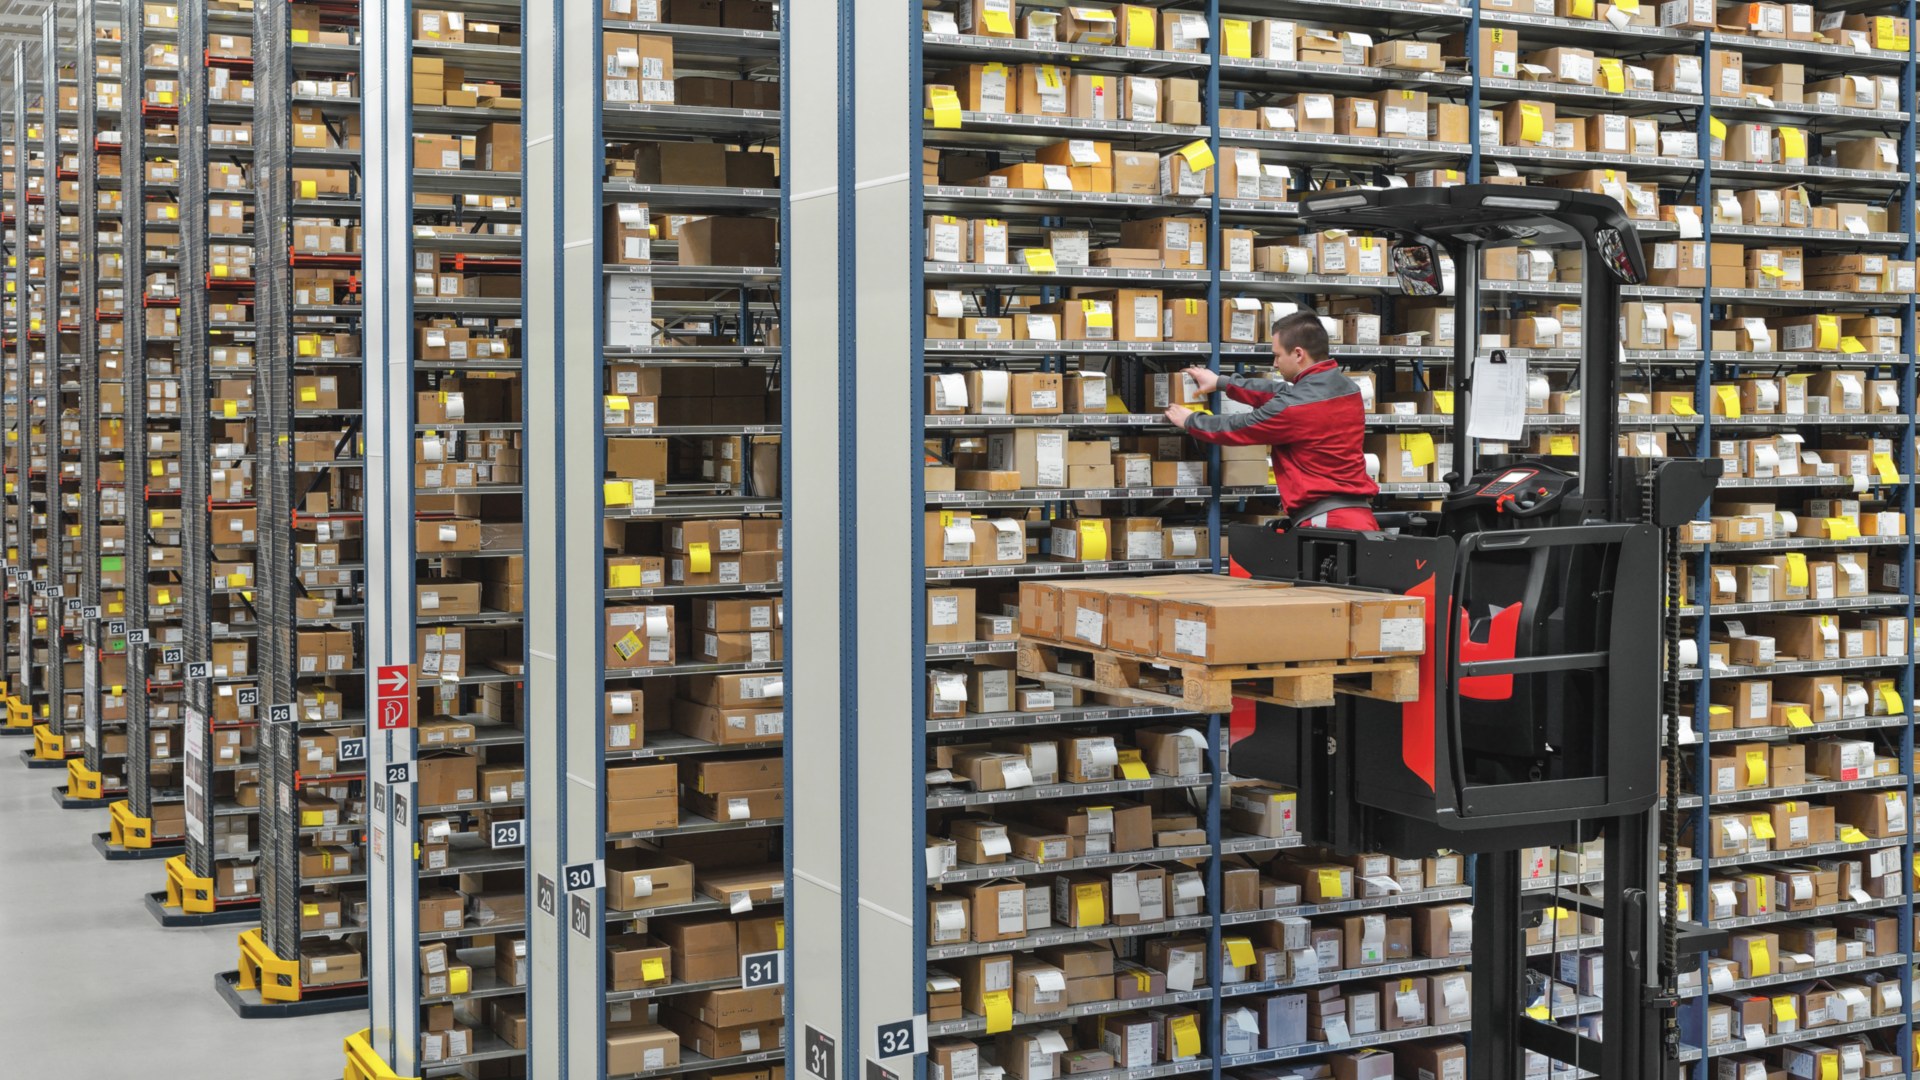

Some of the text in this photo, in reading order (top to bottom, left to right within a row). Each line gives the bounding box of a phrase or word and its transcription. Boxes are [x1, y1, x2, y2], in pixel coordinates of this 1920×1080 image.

[70, 601, 80, 609] 19
[85, 609, 95, 617] 20
[130, 633, 142, 641] 22
[166, 652, 180, 661] 23
[191, 666, 205, 676] 24
[241, 692, 255, 703] 25
[273, 709, 288, 720] 26
[344, 743, 361, 757] 27
[388, 767, 406, 782] 28
[376, 792, 384, 811] 27
[396, 803, 405, 823] 28
[497, 827, 517, 844] 29
[569, 869, 591, 888] 30
[540, 887, 551, 912] 29
[575, 908, 587, 934] 30
[750, 960, 772, 982] 31
[882, 1028, 911, 1053] 32
[811, 1044, 828, 1079] 31
